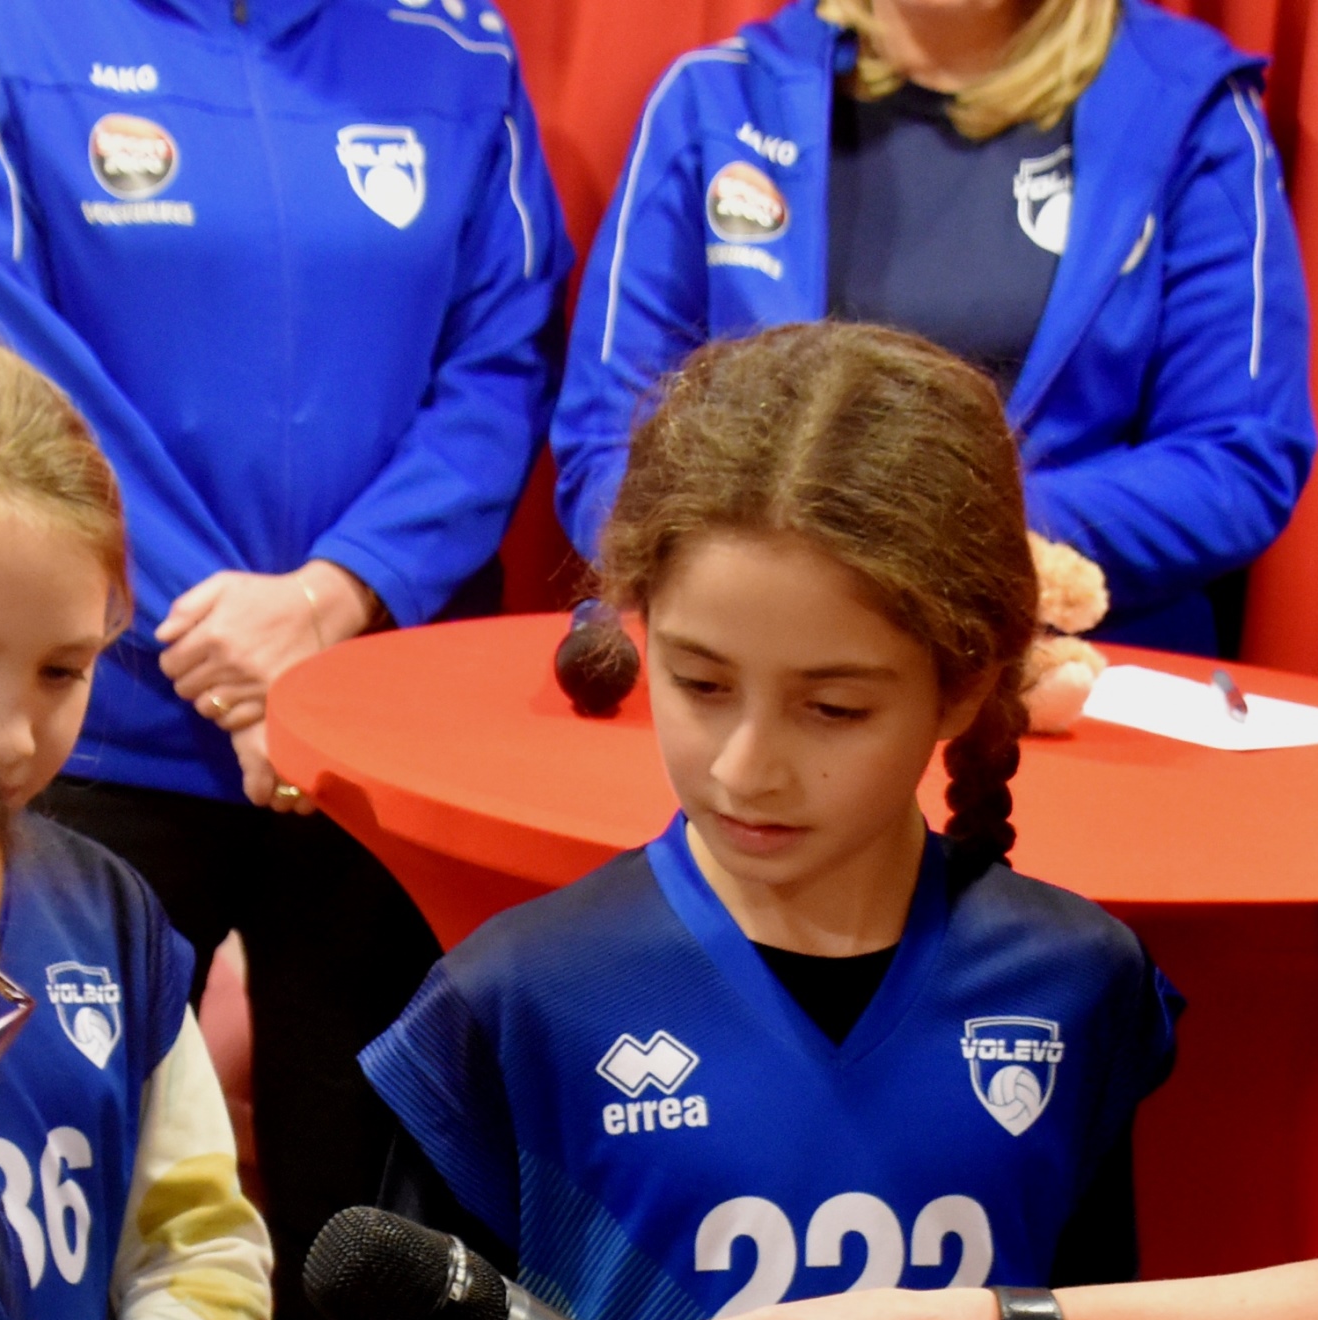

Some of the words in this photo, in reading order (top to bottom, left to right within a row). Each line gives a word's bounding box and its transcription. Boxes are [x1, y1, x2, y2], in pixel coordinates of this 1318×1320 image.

[90, 62, 158, 93] JAKO
[736, 121, 798, 167] JAKO
[46, 982, 122, 1005] VOLEVO
[961, 1037, 1066, 1064] VOLEVO
